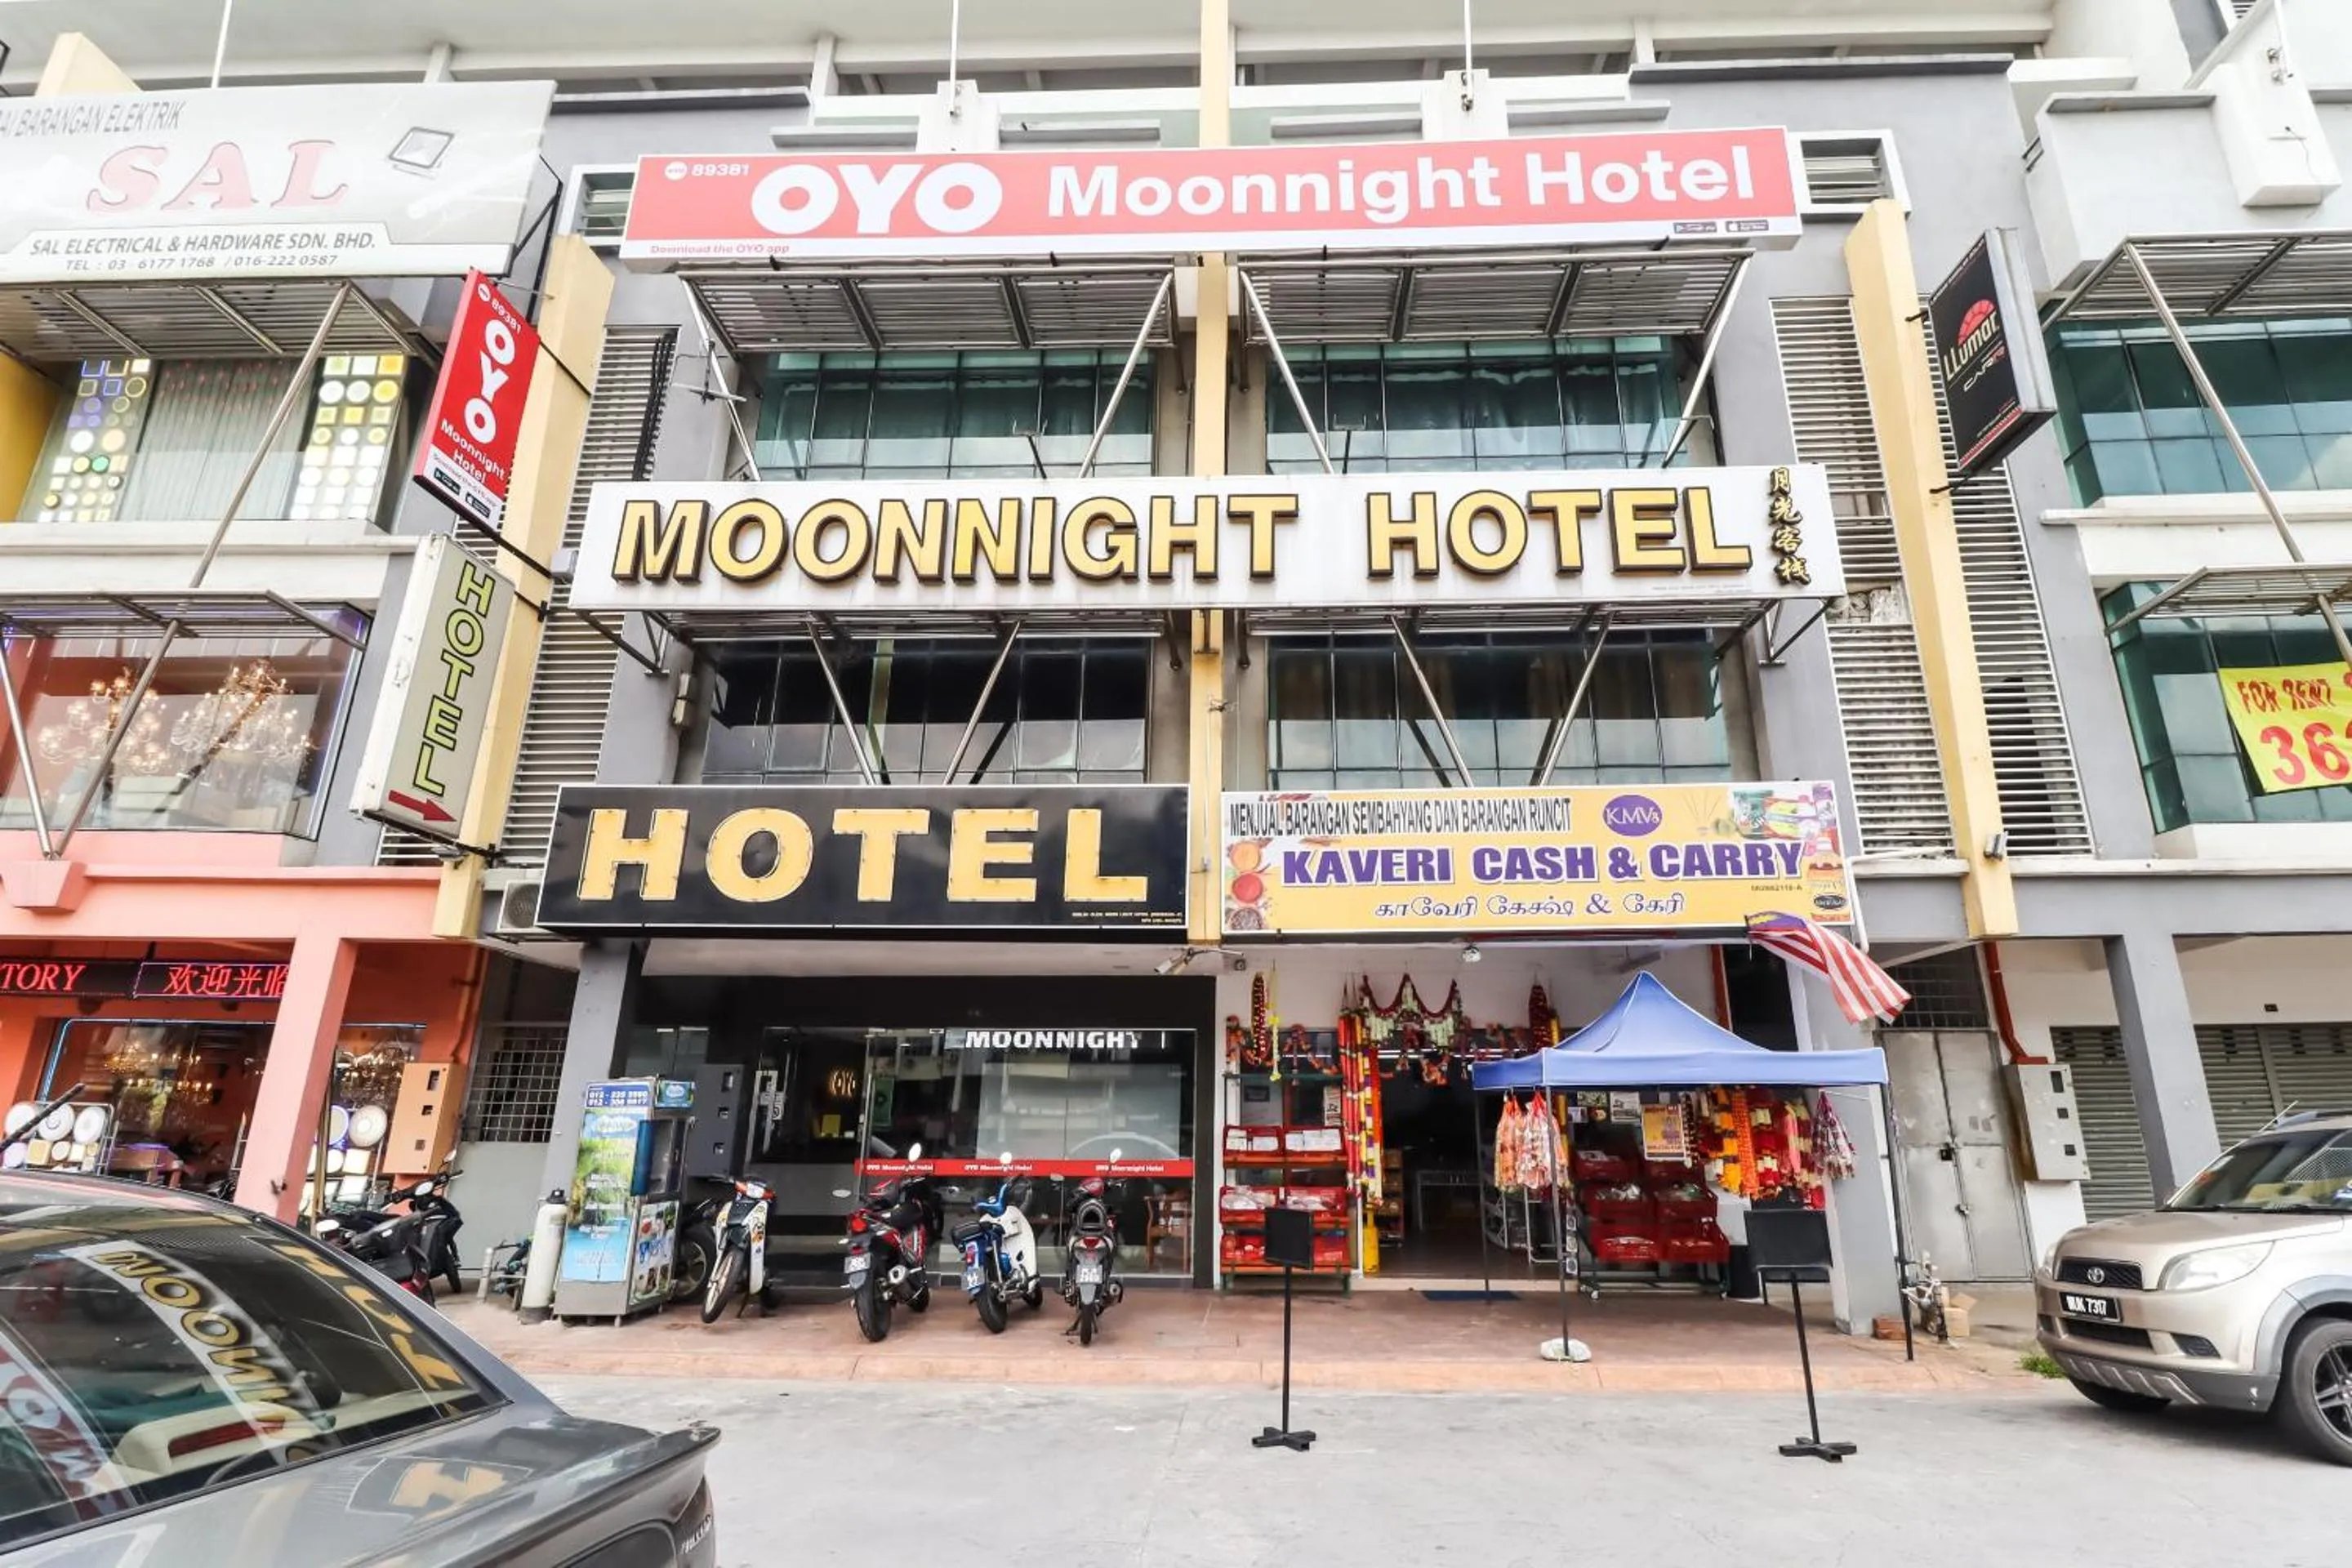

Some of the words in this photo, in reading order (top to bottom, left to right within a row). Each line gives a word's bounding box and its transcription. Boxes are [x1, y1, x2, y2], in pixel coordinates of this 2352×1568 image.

[15, 104, 104, 136] BARANGAN
[104, 100, 186, 132] ELEKTRIK
[86, 139, 349, 215] SAL
[692, 163, 750, 176] 89381
[751, 162, 1004, 234] OYO
[1048, 154, 1502, 224] Moonnight
[1525, 145, 1754, 207] Hotel
[30, 238, 59, 255] SAL
[65, 237, 163, 255] ELECTRICAL
[167, 236, 180, 252] &
[184, 234, 286, 251] HARDWARE
[287, 233, 328, 249] SDN.
[333, 232, 376, 248] BHD.
[66, 260, 89, 270] TEL
[108, 259, 127, 270] 03
[137, 258, 175, 269] 6177
[180, 257, 216, 268] 1768
[298, 255, 338, 266] 0587
[650, 244, 710, 254] Download
[736, 243, 764, 253] OYO
[491, 297, 522, 334] 89381
[464, 319, 515, 443] OYO
[440, 419, 506, 481] Moonnight
[452, 449, 488, 484] Hotel
[612, 494, 1299, 583] MOONNIGHT
[1366, 486, 1754, 578] HOTEL
[412, 560, 496, 797] HOTEL
[2237, 679, 2282, 714] FOR
[2283, 678, 2336, 711] RENT
[2260, 721, 2352, 785] 36
[1230, 802, 1283, 836] MENJUAL
[1286, 800, 1349, 835] BARANGAN
[1352, 799, 1431, 834] SEMBAHYANG
[1433, 800, 1459, 833] DAN
[1460, 798, 1526, 832] BARANGAN
[1528, 797, 1570, 831] RUNCIT
[577, 808, 1149, 902] HOTEL
[1283, 848, 1453, 884] KAVERI
[1472, 846, 1596, 880] CASH
[1608, 846, 1639, 880] &
[1649, 842, 1802, 878] CARRY
[1586, 893, 1612, 914] &
[1, 964, 86, 991] TORY
